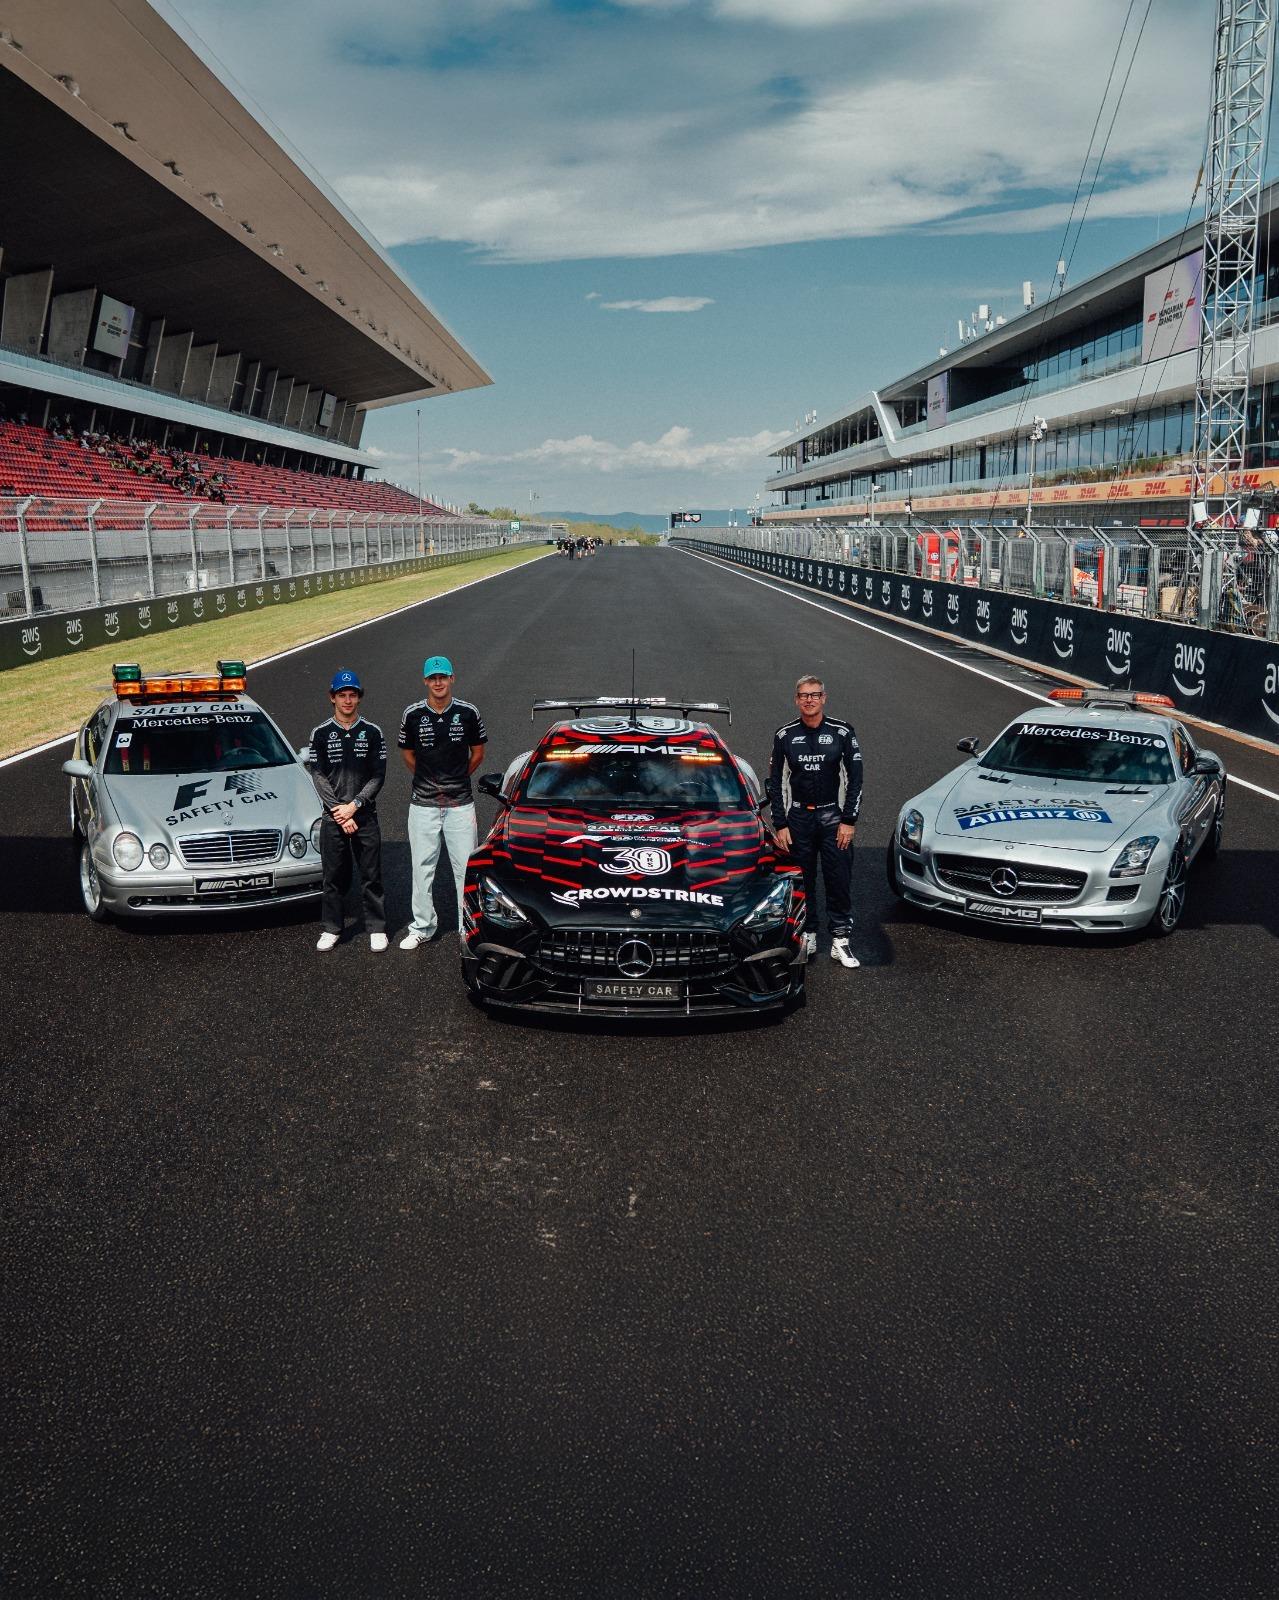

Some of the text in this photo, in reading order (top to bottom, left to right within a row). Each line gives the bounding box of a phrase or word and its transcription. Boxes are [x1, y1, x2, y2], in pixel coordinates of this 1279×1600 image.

[168, 601, 178, 614] aws
[947, 594, 959, 611] aws
[976, 600, 990, 619] aws
[105, 612, 119, 626] aws
[139, 606, 150, 619] aws
[1012, 608, 1027, 628] aws
[66, 619, 82, 634] aws
[1054, 617, 1073, 640] aws
[22, 627, 40, 644] aws
[1107, 628, 1131, 656] aws
[1174, 643, 1205, 674] aws
[132, 705, 202, 716] SAFETY
[132, 714, 253, 728] Mercedes-Benz
[819, 735, 832, 743] FIA
[1018, 725, 1152, 747] Mercedes-Benz
[614, 744, 698, 755] AMG
[166, 792, 278, 826] SAFETY CAR
[953, 798, 1100, 814] SAFETY CAR
[969, 809, 1070, 827] Allianz
[599, 847, 671, 875] 30
[222, 877, 269, 888] AMG
[564, 888, 723, 906] CROWDSTRIKE
[990, 906, 1038, 918] AMG
[597, 984, 672, 995] SAFETY CAR
